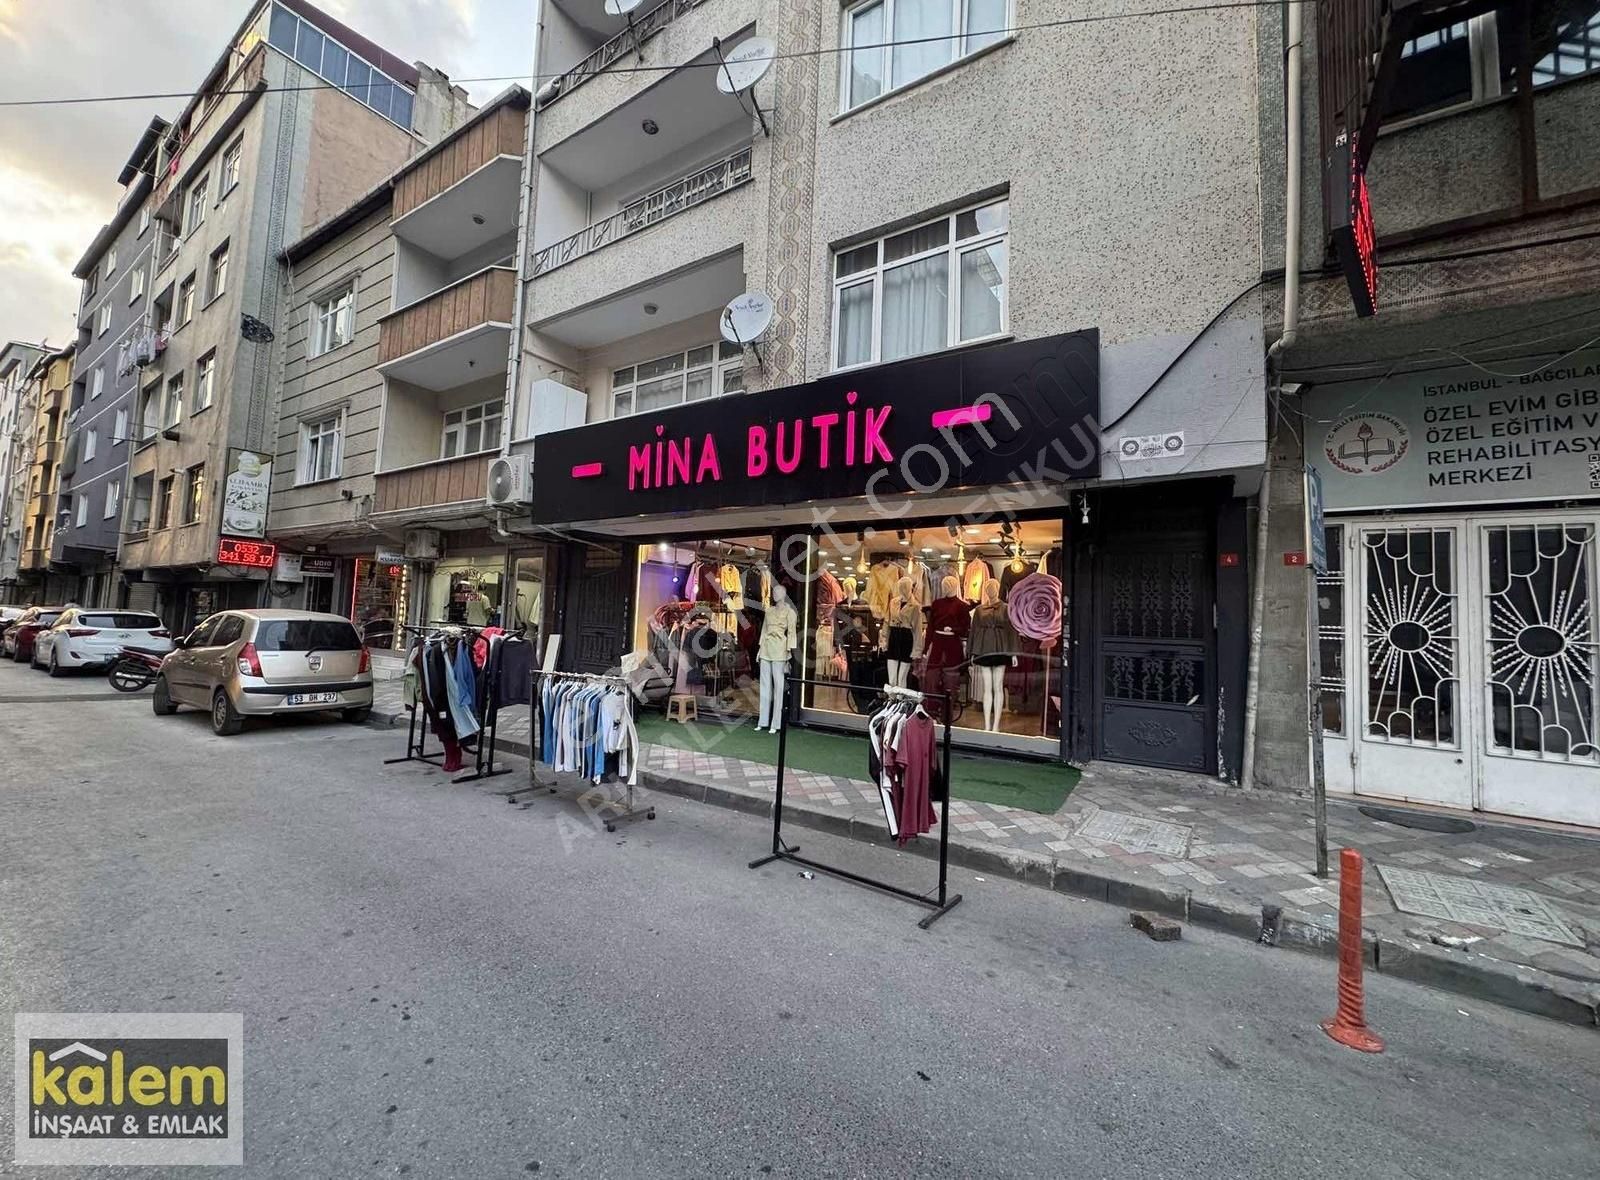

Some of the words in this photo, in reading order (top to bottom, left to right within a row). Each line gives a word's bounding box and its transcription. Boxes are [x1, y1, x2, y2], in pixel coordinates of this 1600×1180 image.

[1424, 404, 1481, 424] ÖZEL
[1489, 395, 1546, 416] EVİM
[628, 425, 720, 490] MİNA
[747, 391, 894, 478] BUTİK
[1426, 425, 1484, 445] ÖZEL
[1491, 414, 1574, 438] EĞİTİM
[1429, 462, 1532, 487] MERKEZİ
[220, 550, 240, 561] 341
[242, 553, 257, 563] 58
[260, 555, 272, 564] 17
[234, 543, 260, 555] 0532
